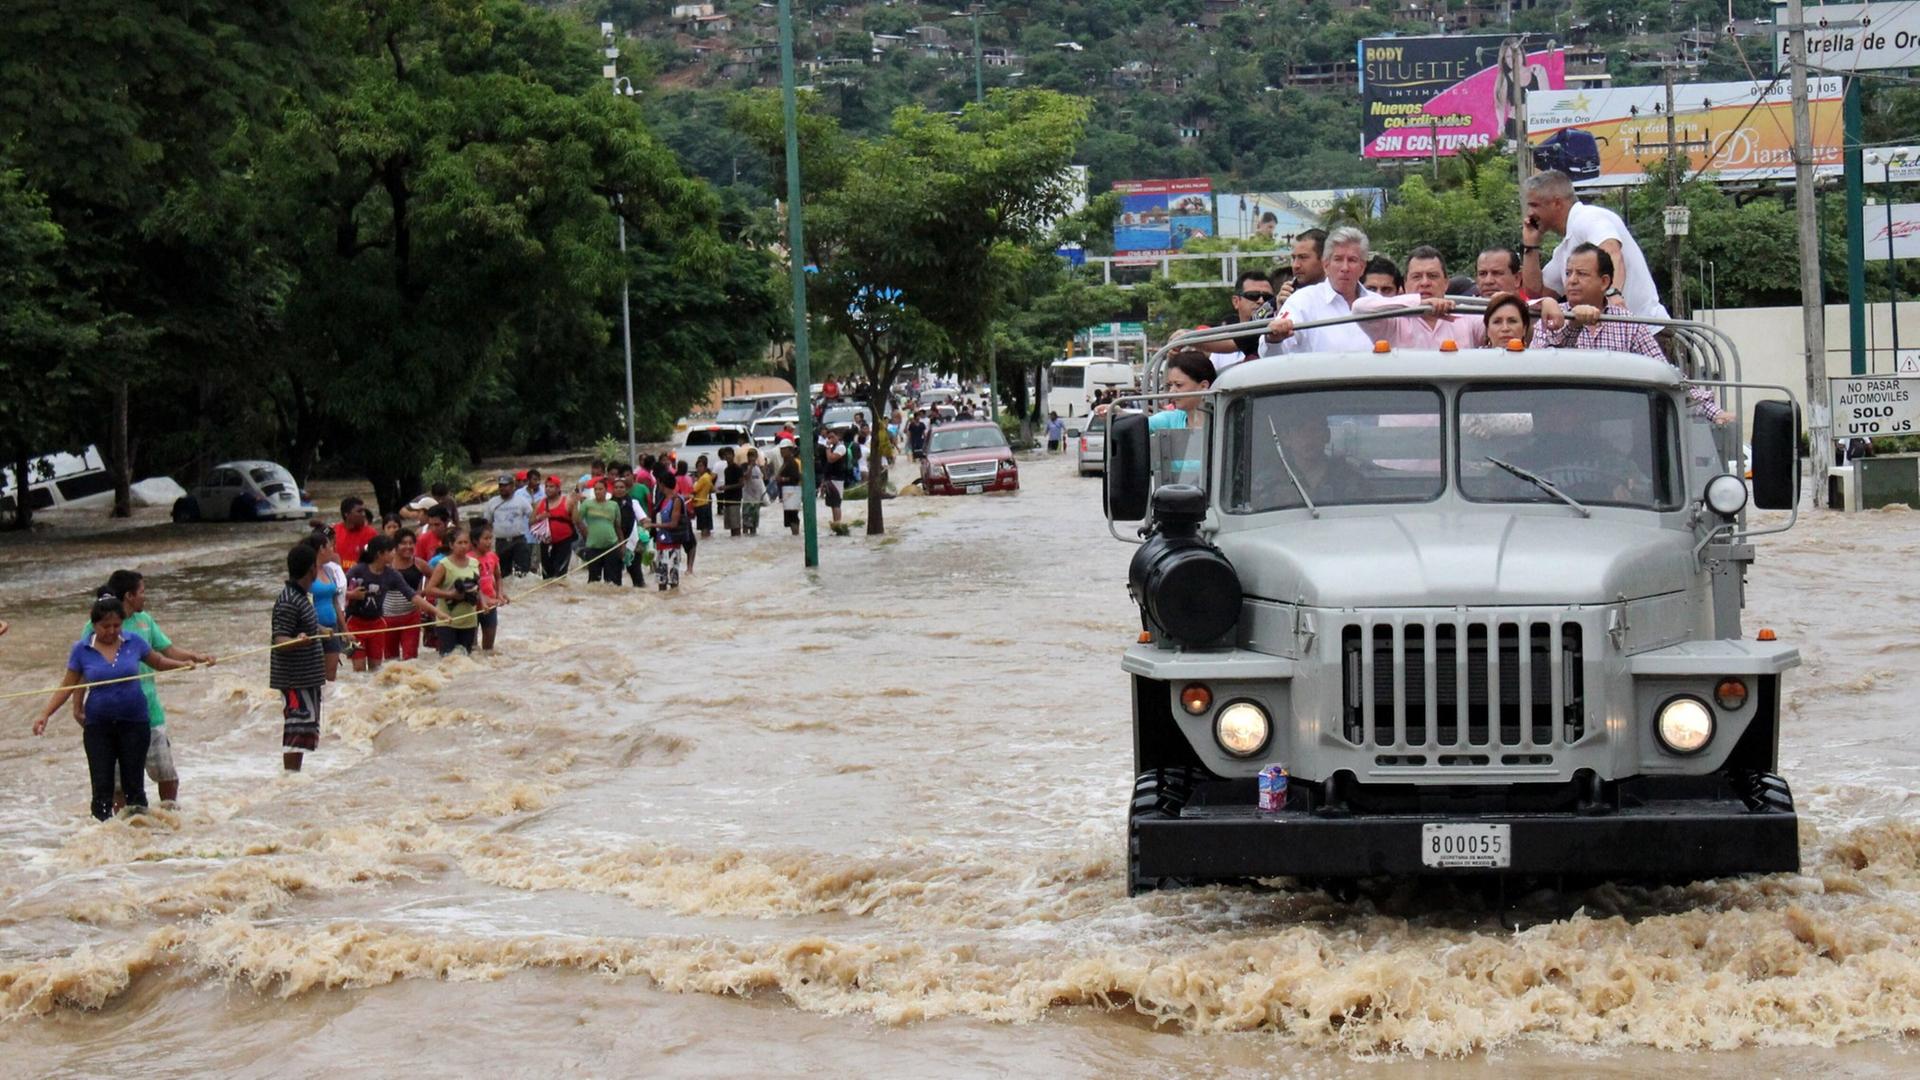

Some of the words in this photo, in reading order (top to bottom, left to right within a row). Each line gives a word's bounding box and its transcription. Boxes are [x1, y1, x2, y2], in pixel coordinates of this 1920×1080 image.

[1782, 34, 1854, 55] Etrella
[1863, 32, 1886, 50] de
[1366, 47, 1404, 62] BODY
[1367, 61, 1467, 81] SILUETTE
[1389, 88, 1469, 97] INTIMATES
[1370, 101, 1423, 116] Nuevos
[1529, 116, 1560, 125] Estrella
[1574, 115, 1591, 123] Oro
[1375, 134, 1403, 152] SIN
[1406, 132, 1490, 151] COSTURAS
[1848, 383, 1862, 392] NO
[1867, 380, 1900, 391] PASAR
[1840, 391, 1909, 405] AUTOMOVILES
[1853, 406, 1894, 419] SOLO
[1432, 835, 1501, 853] 800055
